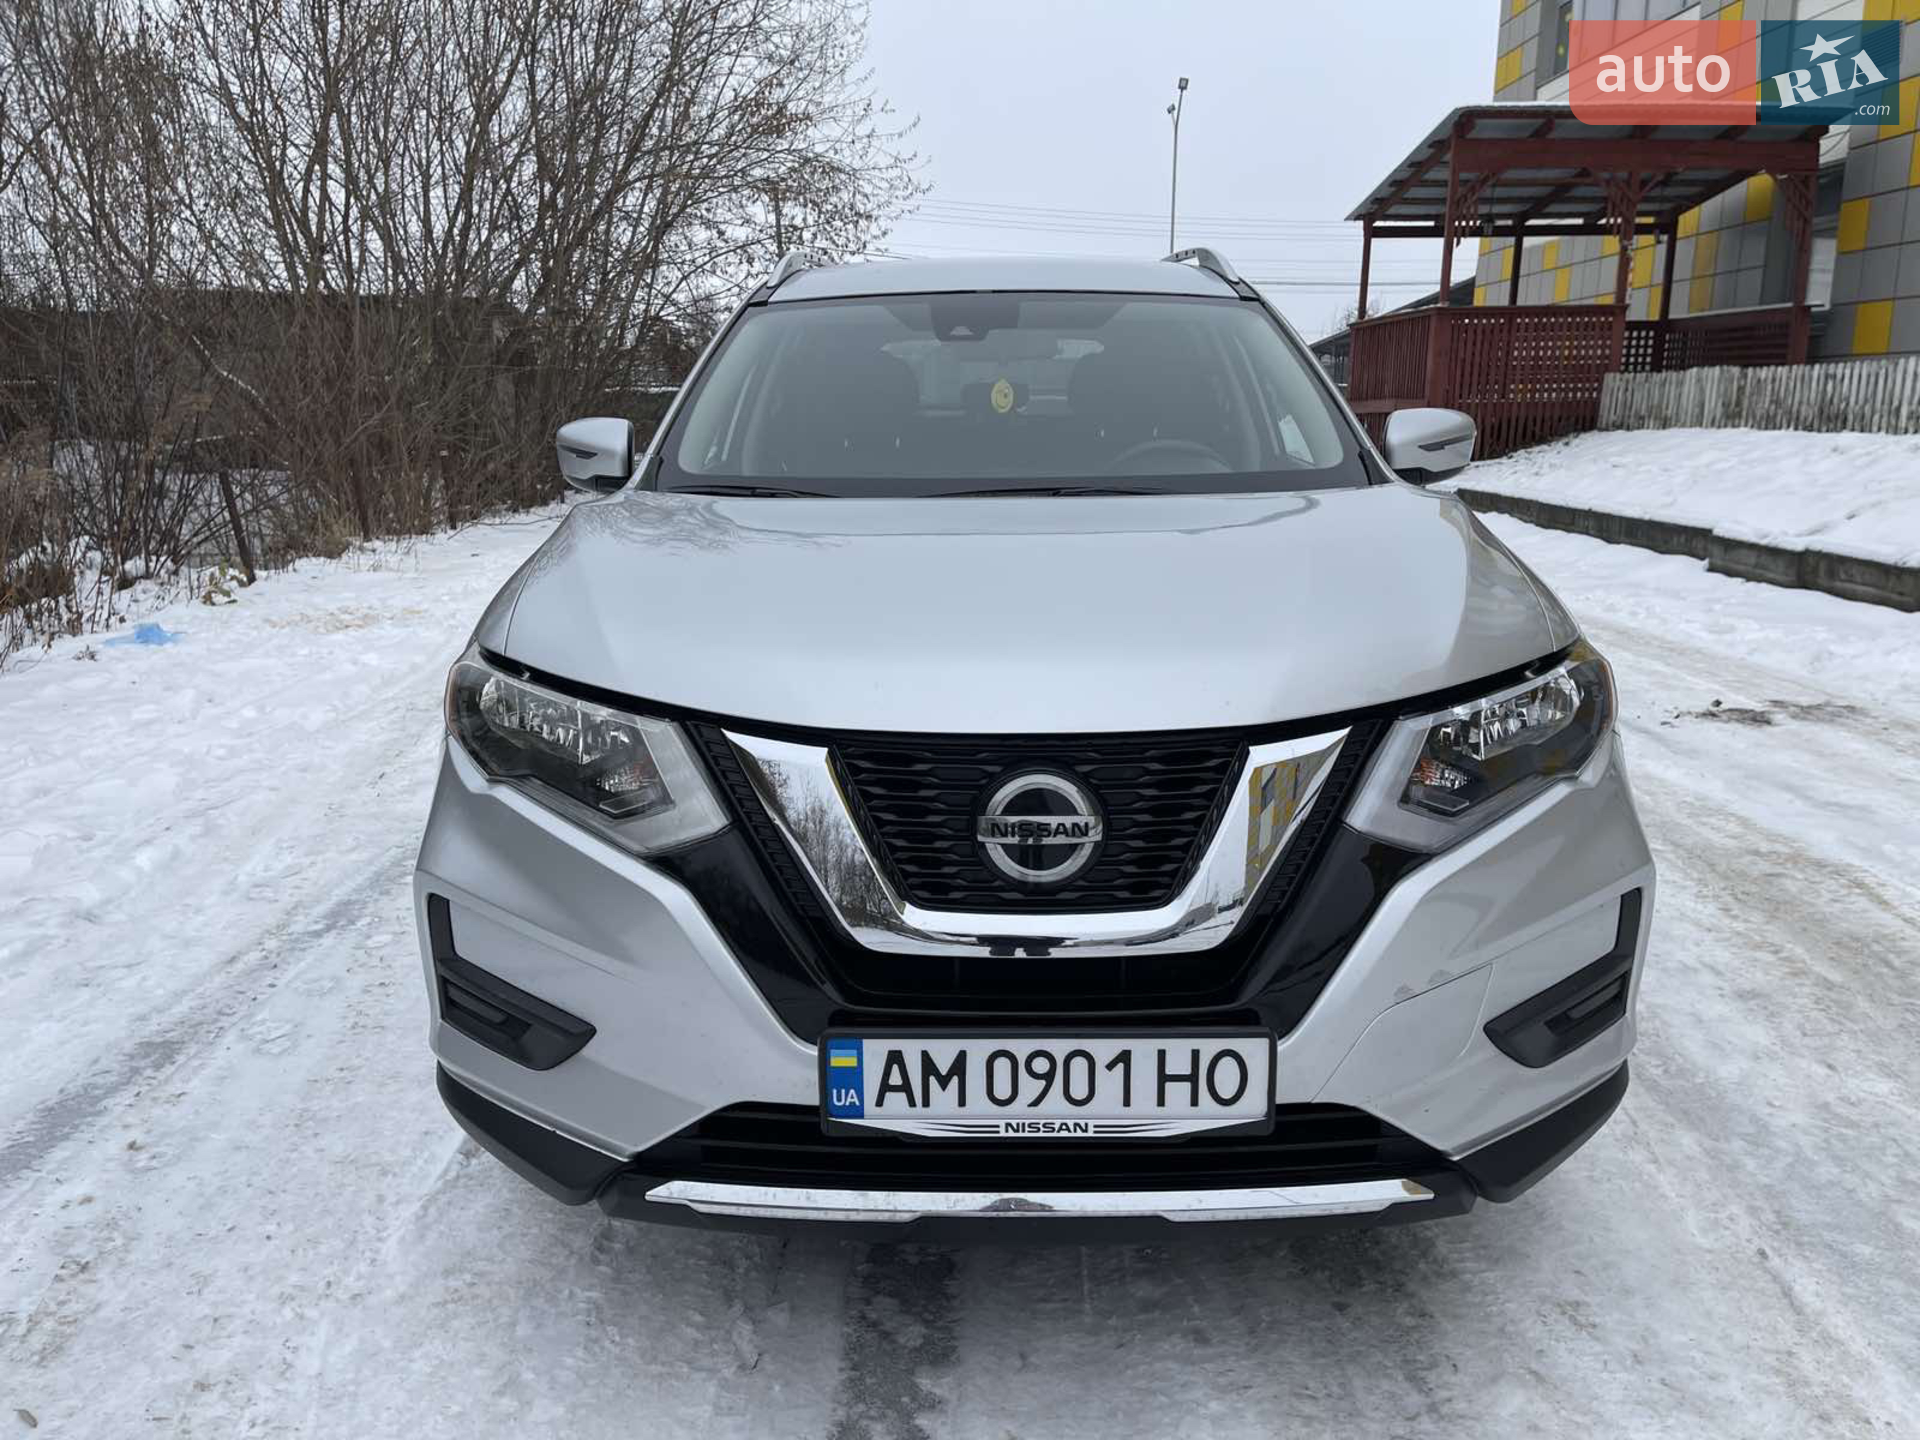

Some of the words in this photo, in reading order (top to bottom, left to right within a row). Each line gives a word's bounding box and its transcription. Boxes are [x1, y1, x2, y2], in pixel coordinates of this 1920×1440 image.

[989, 822, 1089, 838] NISSAN
[874, 1049, 968, 1108] AM
[985, 1048, 1133, 1108] 0901
[1156, 1048, 1249, 1108] HO
[832, 1088, 860, 1107] UA
[1004, 1121, 1090, 1135] NISSAN
